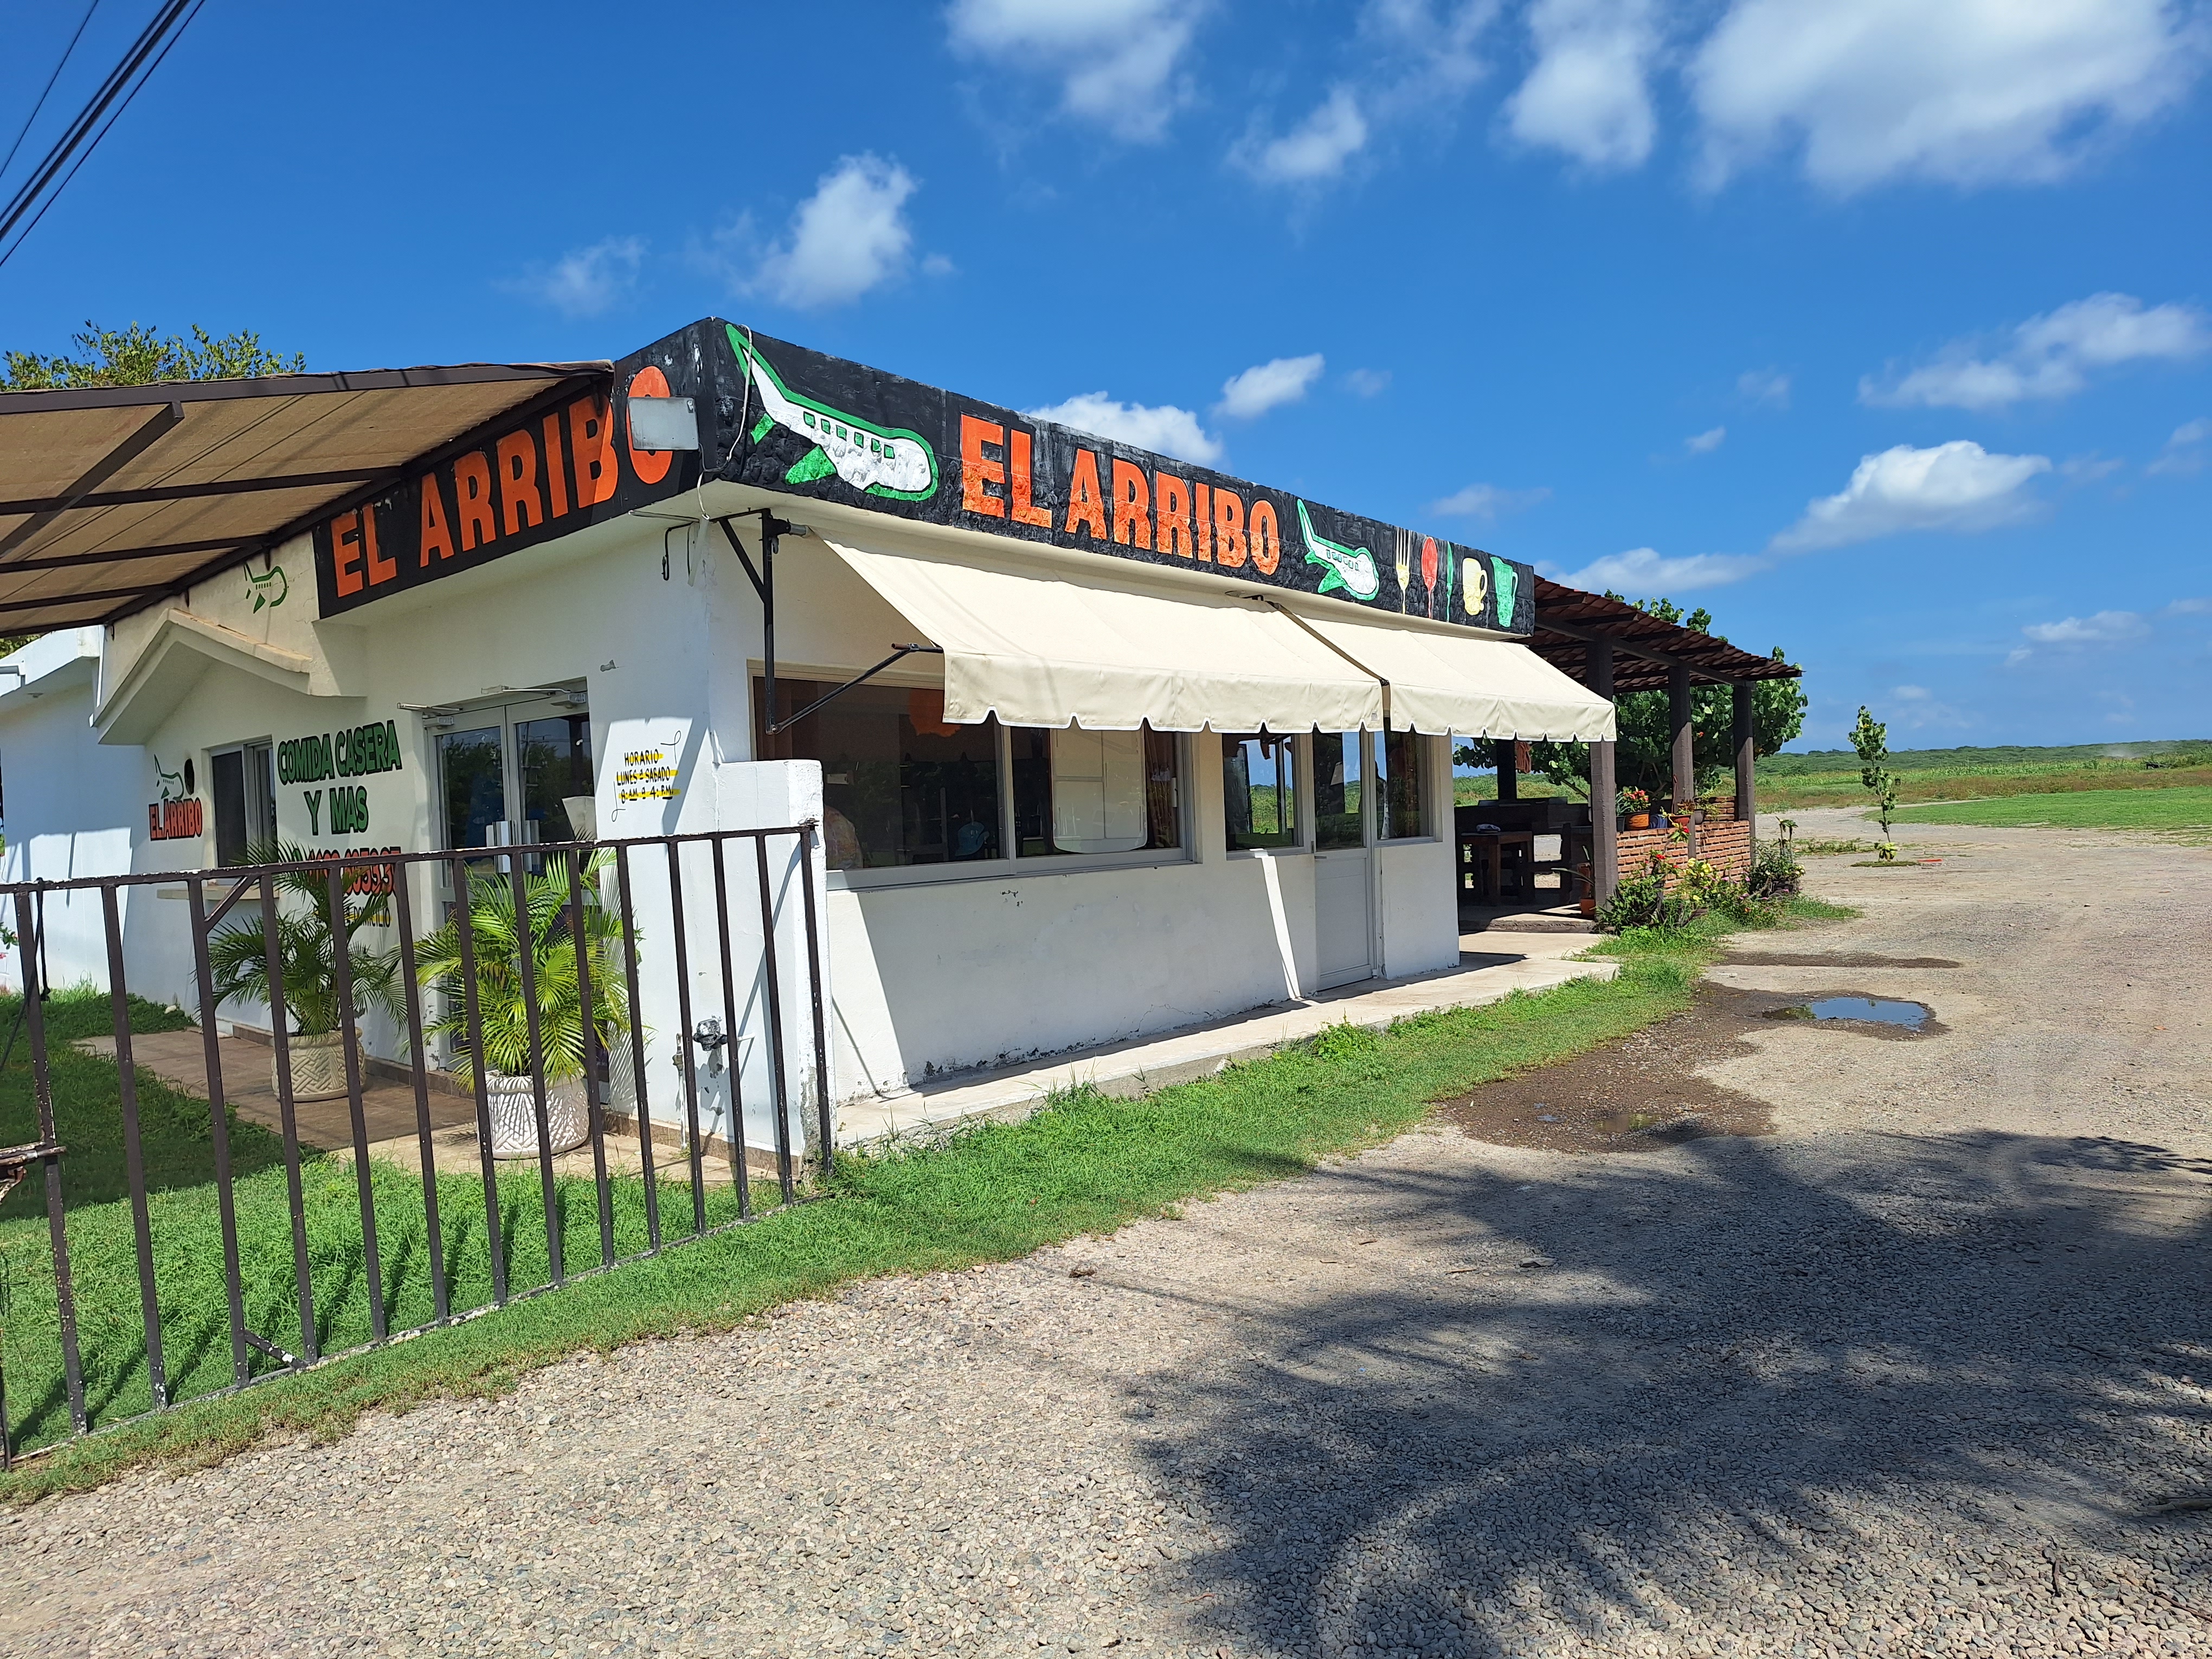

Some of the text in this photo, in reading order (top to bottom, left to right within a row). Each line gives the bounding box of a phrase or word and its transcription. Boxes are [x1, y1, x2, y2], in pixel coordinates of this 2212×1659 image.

[330, 366, 673, 597] EL ARRIBO
[961, 414, 1280, 575] EL ARRIBO
[278, 719, 402, 785] COMIDA CASERA
[617, 769, 637, 786] LUNES
[645, 766, 670, 783] SABADO
[624, 749, 659, 767] HORARIO
[149, 797, 202, 841] EL ARRIBO
[304, 786, 369, 835] Y MAS
